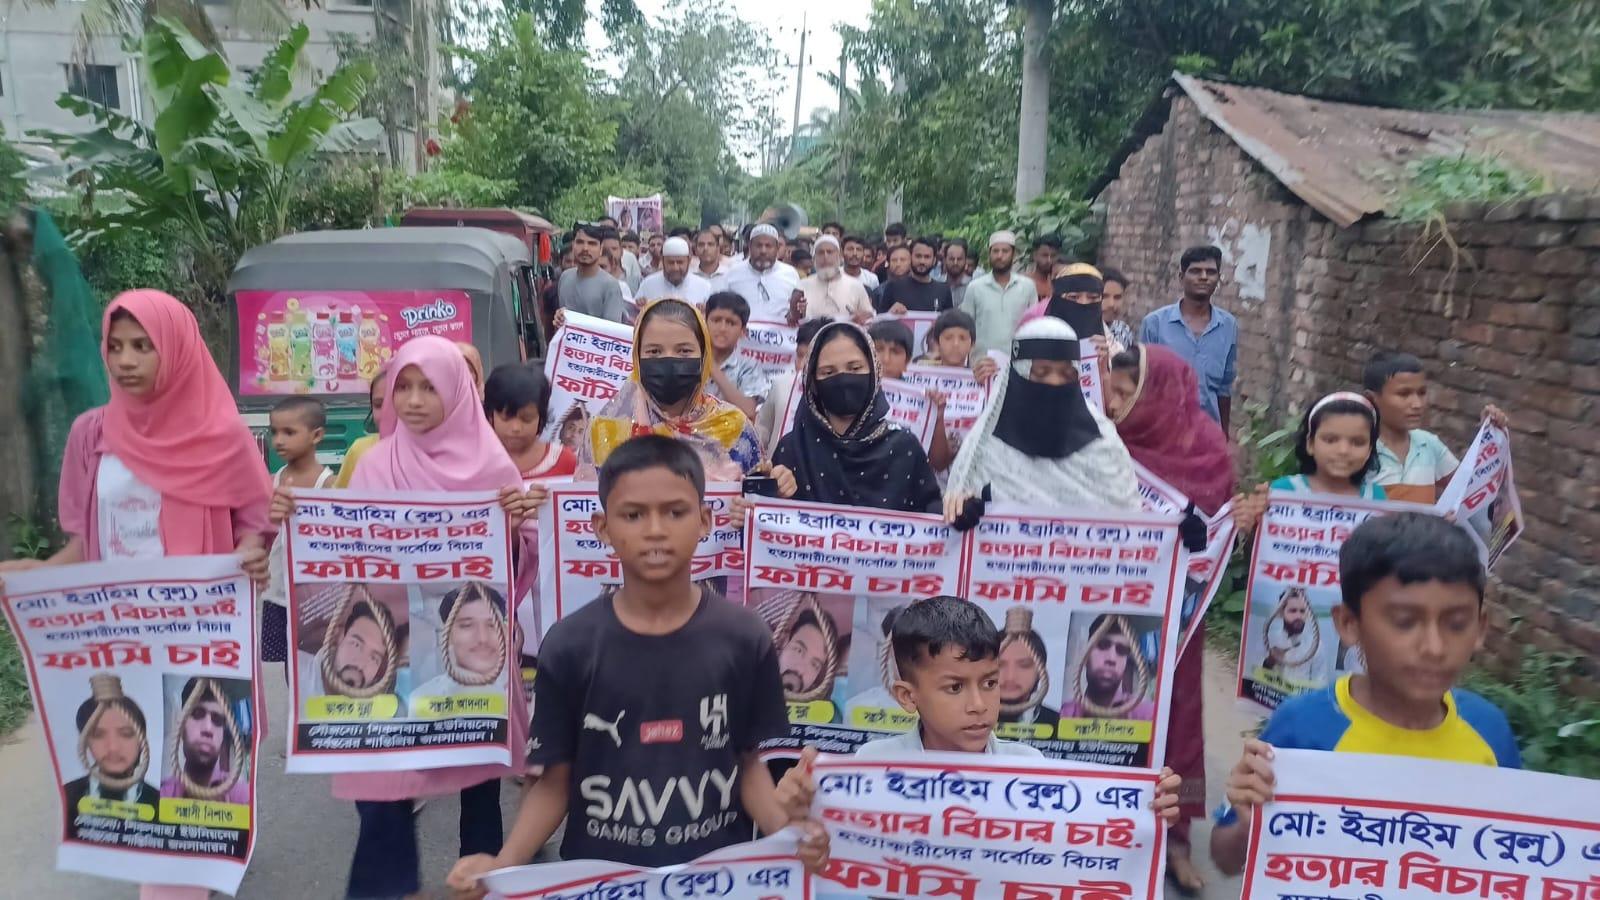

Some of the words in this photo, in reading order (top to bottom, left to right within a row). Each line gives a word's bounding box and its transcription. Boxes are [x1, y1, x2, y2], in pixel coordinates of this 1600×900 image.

[401, 298, 456, 328] Drinko
[591, 335, 632, 355] ইব্রাহিম
[564, 346, 607, 366] হত্যার
[609, 354, 633, 372] বিচ
[557, 374, 620, 400] ফাঁসি
[331, 503, 396, 522] ইব্রাহিম
[460, 506, 491, 520] এর
[797, 510, 861, 531] ইব্রাহিম
[869, 520, 916, 538] (বুলু)
[923, 525, 951, 538] এর
[1301, 501, 1357, 523] ইব্রাহিম
[297, 523, 363, 540] হত্যার
[368, 523, 440, 542] বিচার
[758, 529, 826, 550] হত্যার
[831, 532, 898, 555] বিচার
[1018, 519, 1078, 540] ইব্রাহিম
[1268, 523, 1325, 541] হত্যার
[307, 540, 393, 554] হত্যাকারীদের
[446, 540, 484, 552] বিচার
[767, 546, 851, 565] হত্যাকারীদের
[902, 559, 937, 570] বিচার
[979, 540, 1042, 558] হত্যার
[1048, 539, 1112, 560] বিচার
[1272, 541, 1339, 559] হত্যাকারীদে
[297, 554, 401, 581] ফাঁসি
[412, 555, 494, 580] চাই
[563, 553, 621, 578] ফাঁ
[1115, 561, 1149, 577] বিচার
[754, 562, 855, 592] ফাঁসি
[866, 572, 945, 597] চাই
[973, 574, 1067, 604] ফাঁসি
[1080, 579, 1155, 607] চাই
[65, 585, 139, 606] ইব্রাহিম
[205, 582, 237, 596] এর
[27, 609, 106, 629] হত্যার
[111, 602, 187, 622] বিচার
[197, 620, 232, 633] বিচার
[37, 638, 153, 670] ফাঁসি
[165, 640, 241, 669] চাই
[580, 764, 738, 826] SAVVY
[885, 768, 993, 801] ইব্রাহিম
[1005, 778, 1081, 813] (বুলু)
[1096, 787, 1143, 809] এর
[586, 818, 657, 847] GAMES
[664, 811, 738, 846] GROUP
[822, 808, 931, 834] হত্যার
[943, 806, 1054, 844] বিচার
[1065, 818, 1143, 849] চাই.
[1339, 806, 1463, 850] ইব্রাহিম
[1473, 824, 1565, 868] (বুলু)
[838, 830, 977, 861] হত্যাকারীদের
[982, 848, 1056, 866] সর্বোচ্চ
[1062, 850, 1122, 871] বিচার
[661, 867, 734, 897] (বুলু)
[748, 867, 793, 888] এর
[819, 855, 981, 900] ফাঁসি
[1263, 854, 1389, 888] হত্যার
[1399, 851, 1530, 900] বিচার
